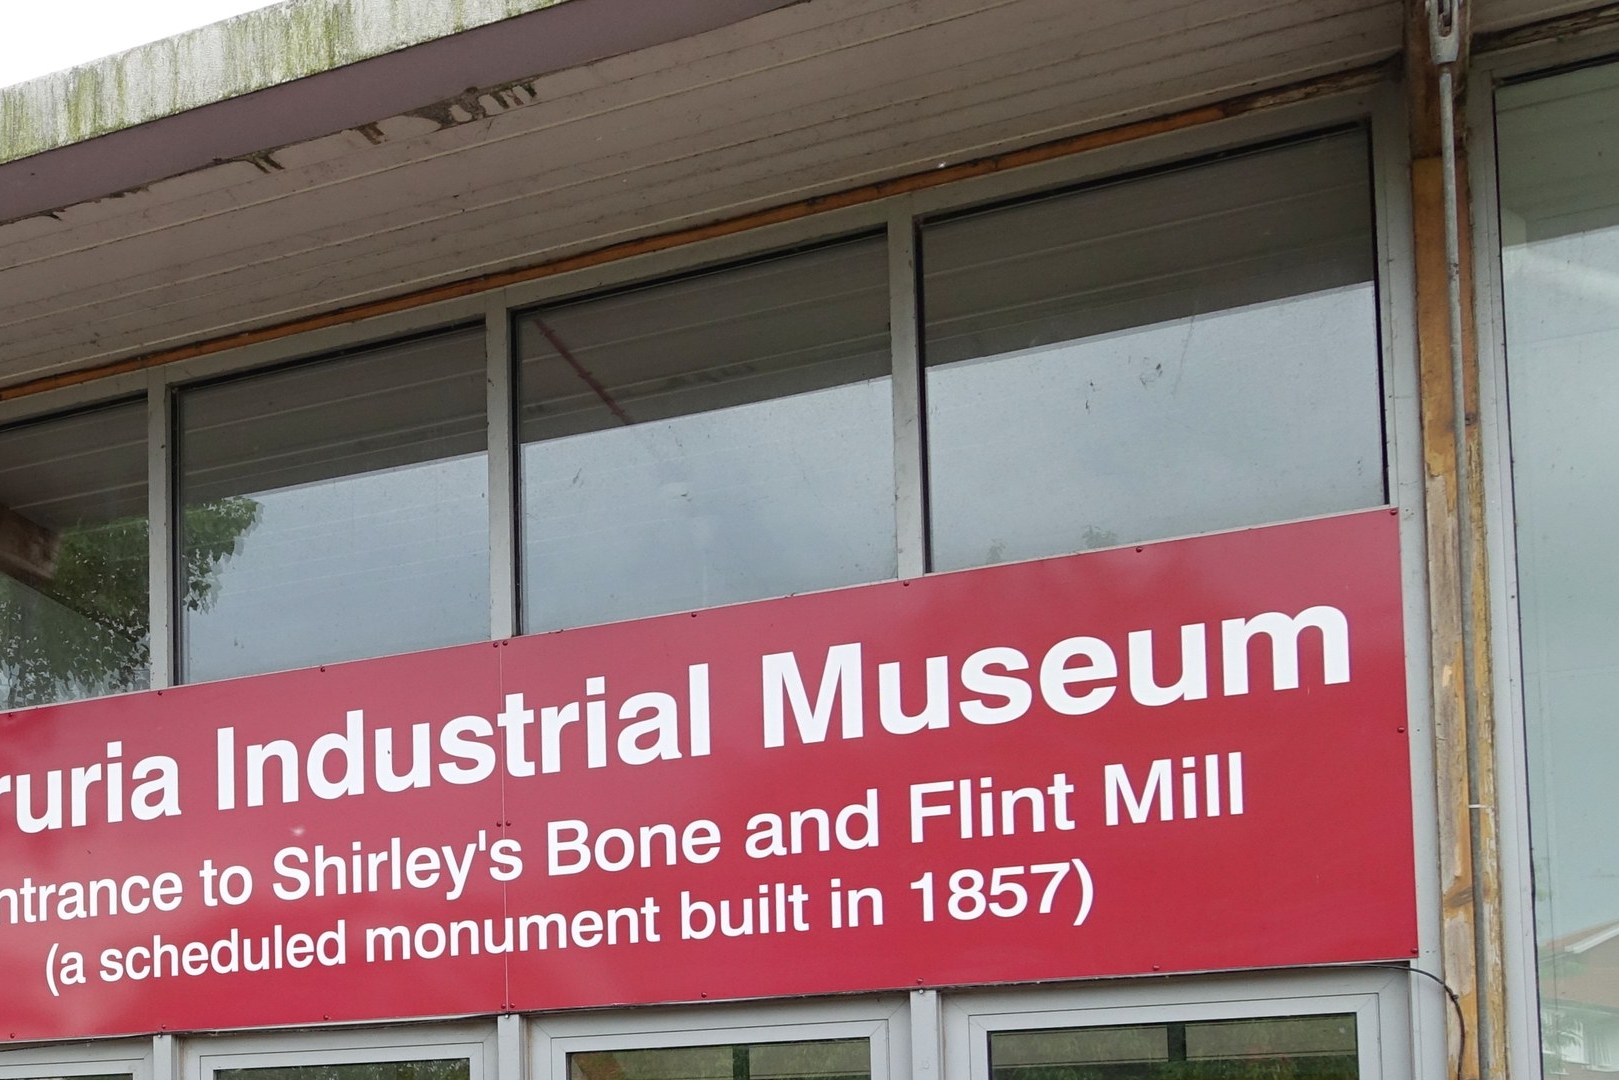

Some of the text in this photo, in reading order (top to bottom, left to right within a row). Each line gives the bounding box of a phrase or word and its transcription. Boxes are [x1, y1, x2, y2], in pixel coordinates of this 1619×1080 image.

[217, 663, 710, 811] Industrial
[763, 605, 1350, 748] Museum
[199, 860, 253, 906] to
[272, 830, 522, 900] Shirley's
[547, 818, 721, 876] Bone
[745, 788, 878, 859] and
[910, 774, 1075, 844] Flint
[1105, 751, 1244, 826] Mill
[45, 859, 1095, 996] (a scheduled monument built in 1857)
